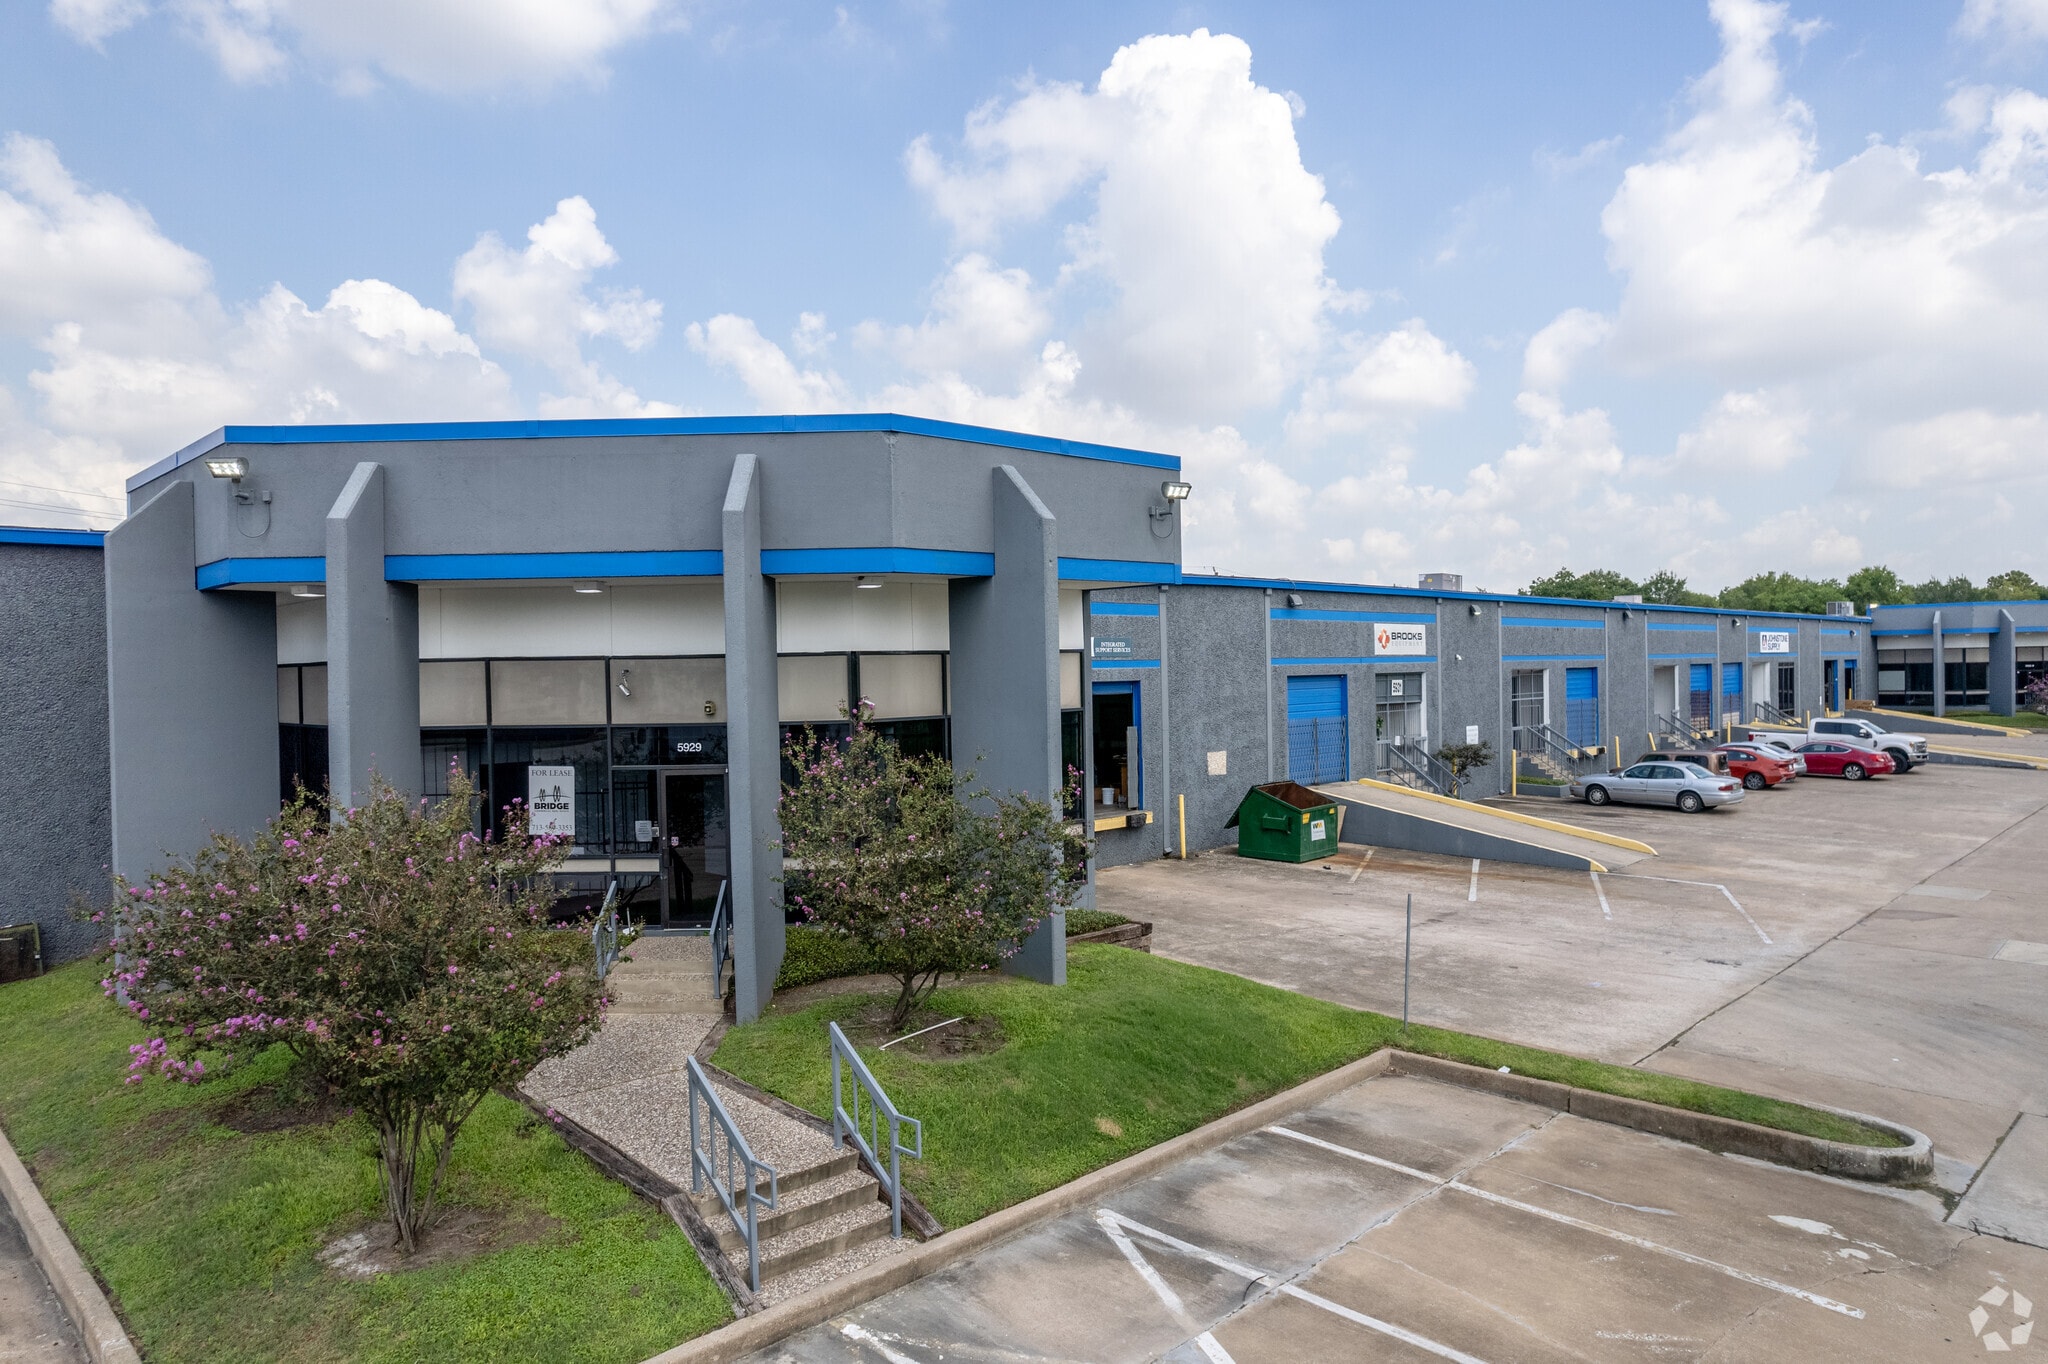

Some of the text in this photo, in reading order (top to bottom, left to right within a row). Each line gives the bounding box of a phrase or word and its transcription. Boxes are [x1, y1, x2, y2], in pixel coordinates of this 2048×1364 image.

[1391, 632, 1423, 640] BROOKS
[677, 742, 702, 752] 5929
[531, 769, 573, 777] FOR LEASE
[534, 802, 570, 810] BRIDGE
